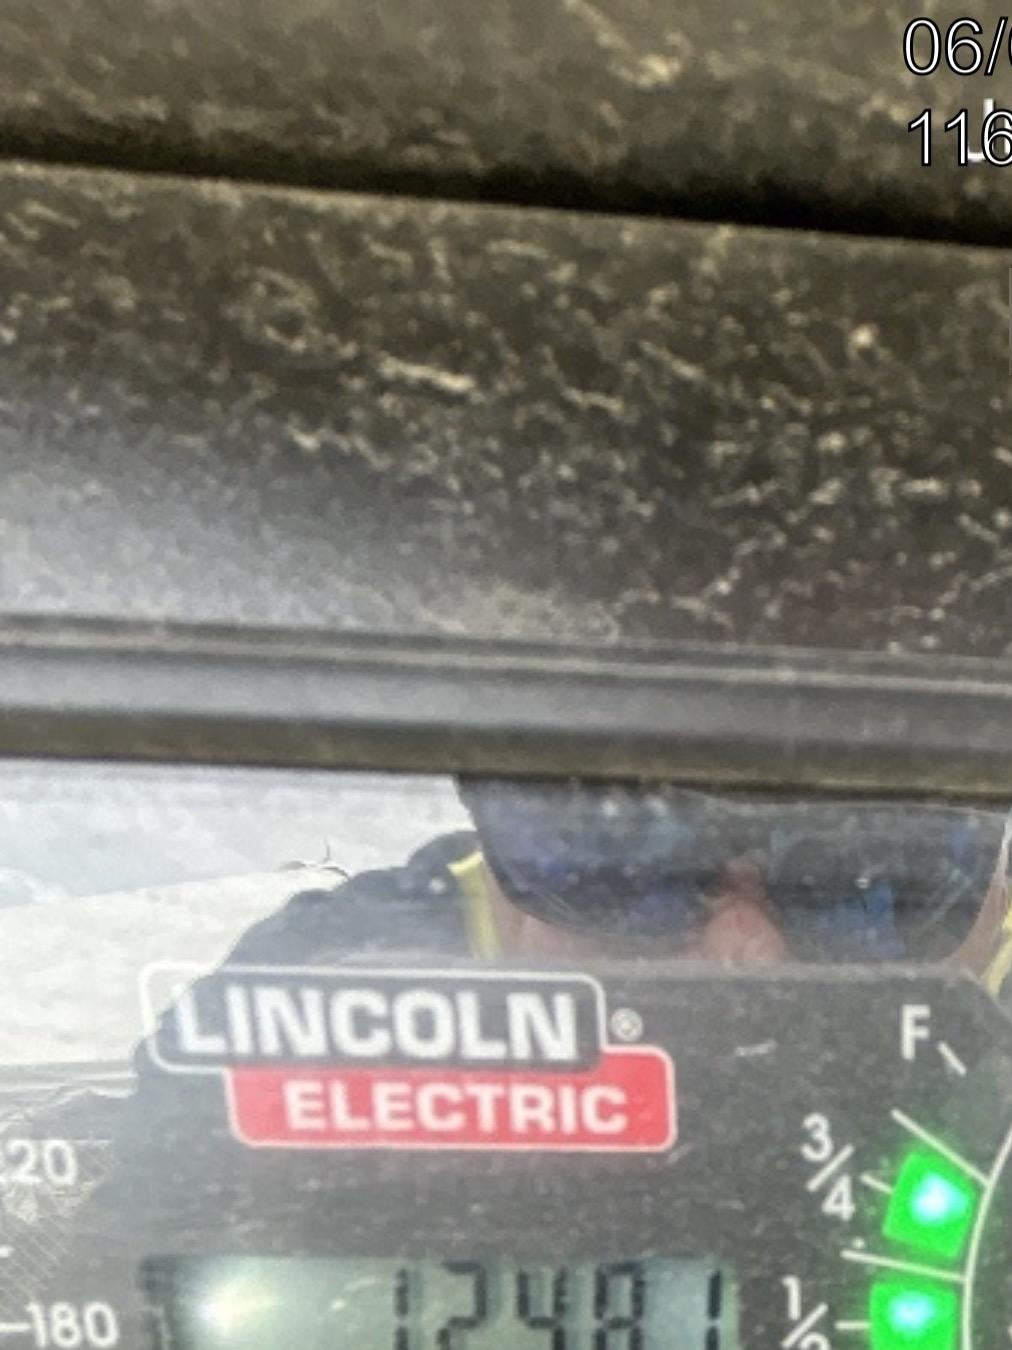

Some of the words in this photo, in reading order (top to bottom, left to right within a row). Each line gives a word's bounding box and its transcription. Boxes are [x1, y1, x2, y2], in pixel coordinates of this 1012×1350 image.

[172, 984, 579, 1061] LINCOLN
[902, 1005, 930, 1060] F
[282, 1079, 628, 1135] ELECTRIC
[0, 1139, 77, 1185] 20
[27, 1302, 118, 1348] 180
